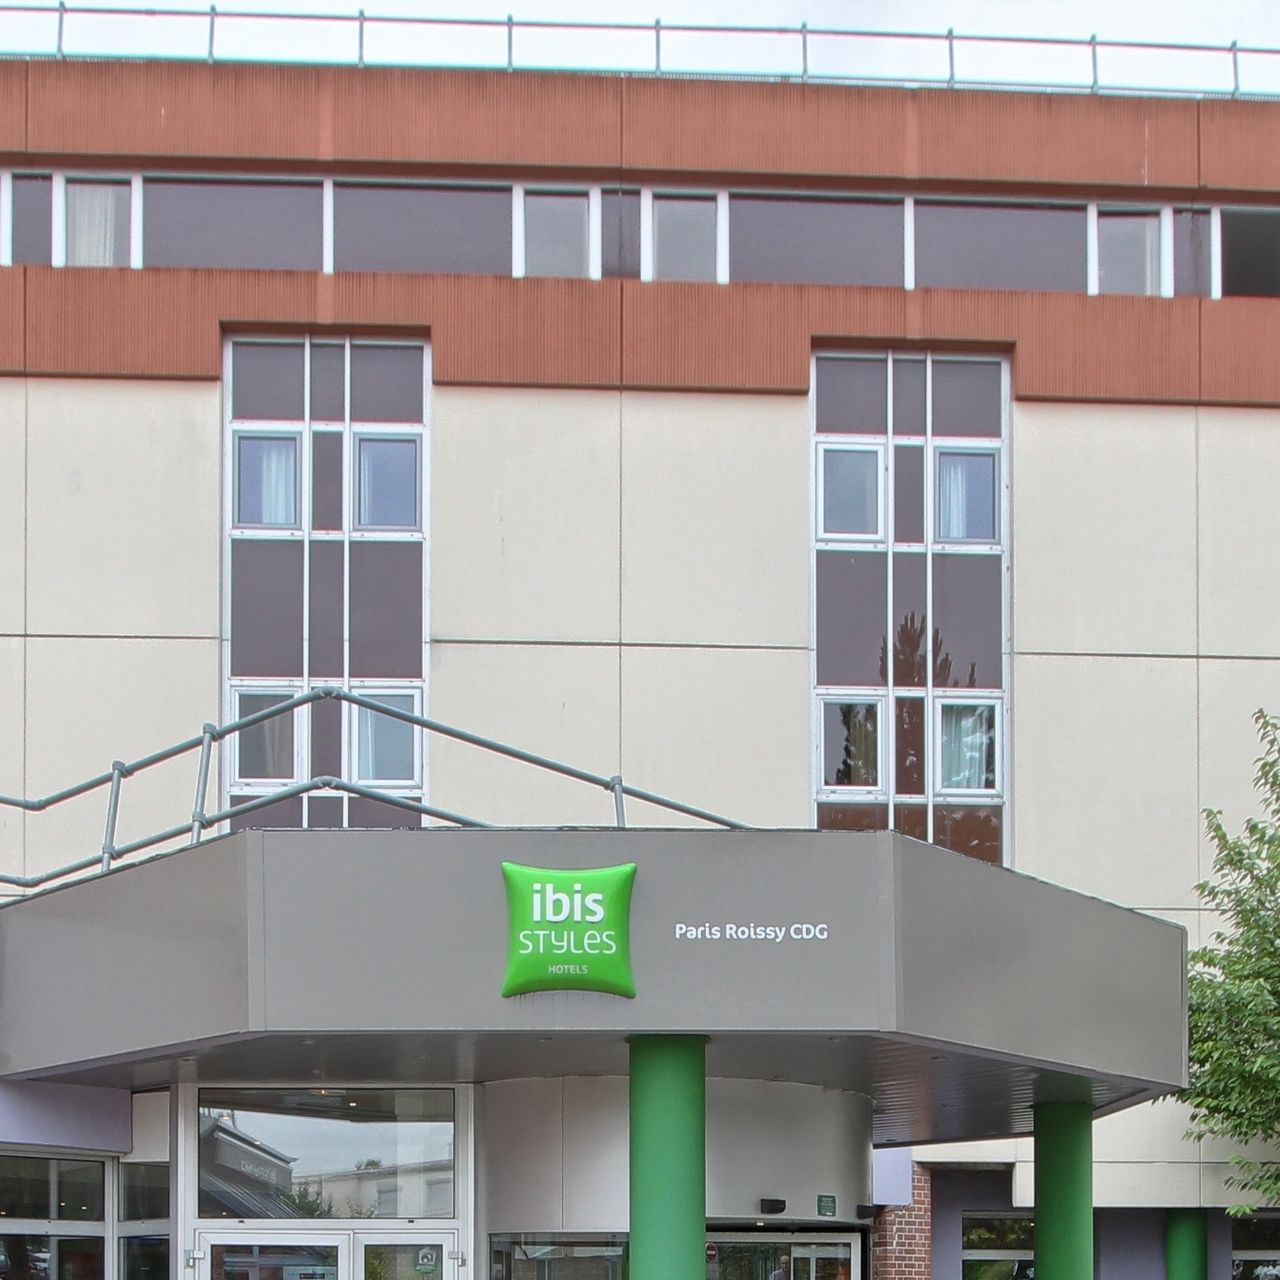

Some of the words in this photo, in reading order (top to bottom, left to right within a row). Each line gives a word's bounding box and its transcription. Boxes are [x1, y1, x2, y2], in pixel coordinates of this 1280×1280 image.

[532, 882, 605, 923] ibis
[674, 923, 721, 940] Paris
[725, 922, 787, 943] Roissy
[789, 923, 829, 940] CDG
[548, 964, 589, 975] HOTELS
